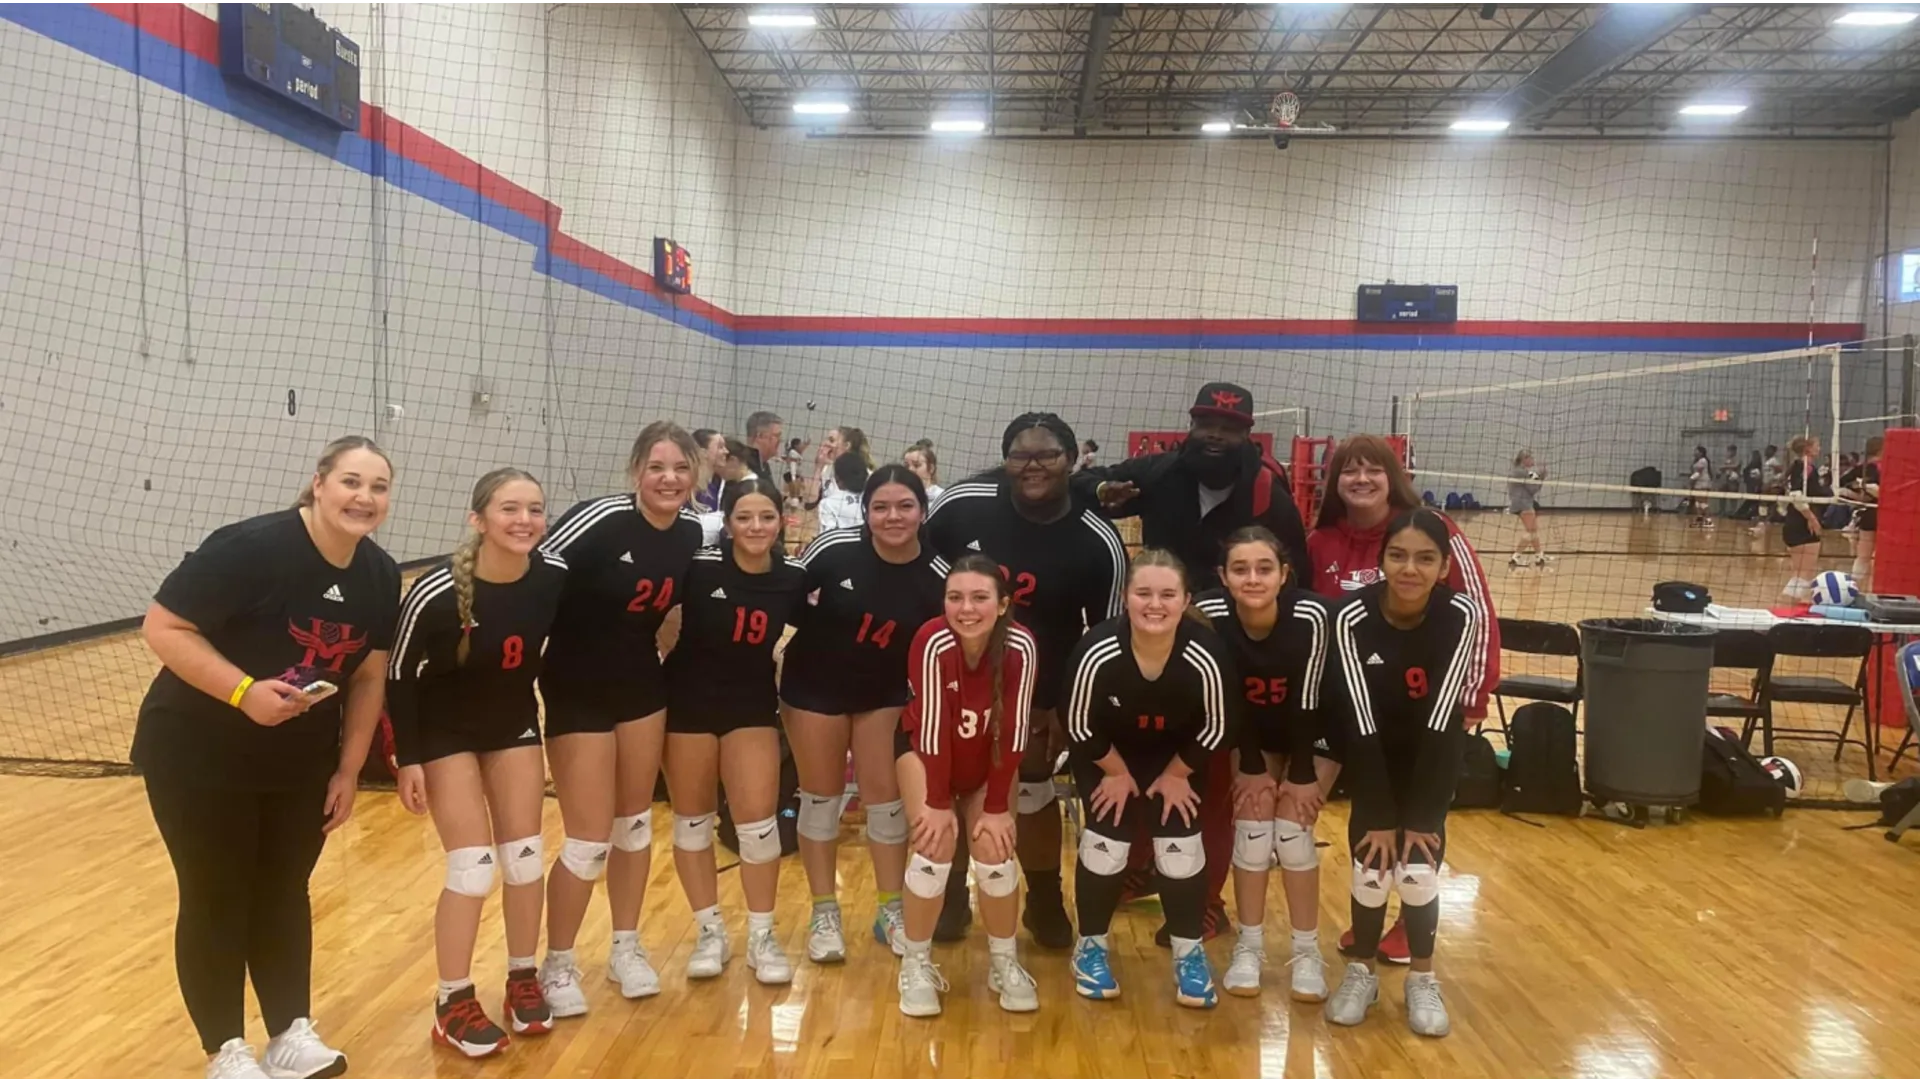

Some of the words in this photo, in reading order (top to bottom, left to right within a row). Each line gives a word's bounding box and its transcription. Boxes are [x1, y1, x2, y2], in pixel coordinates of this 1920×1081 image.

[295, 77, 318, 100] period
[288, 389, 296, 416] 8
[627, 577, 674, 612] 24
[733, 606, 769, 644] 19
[856, 612, 897, 648] 14
[502, 635, 523, 669] 8
[1245, 677, 1288, 704] 25
[1405, 667, 1429, 699] 9
